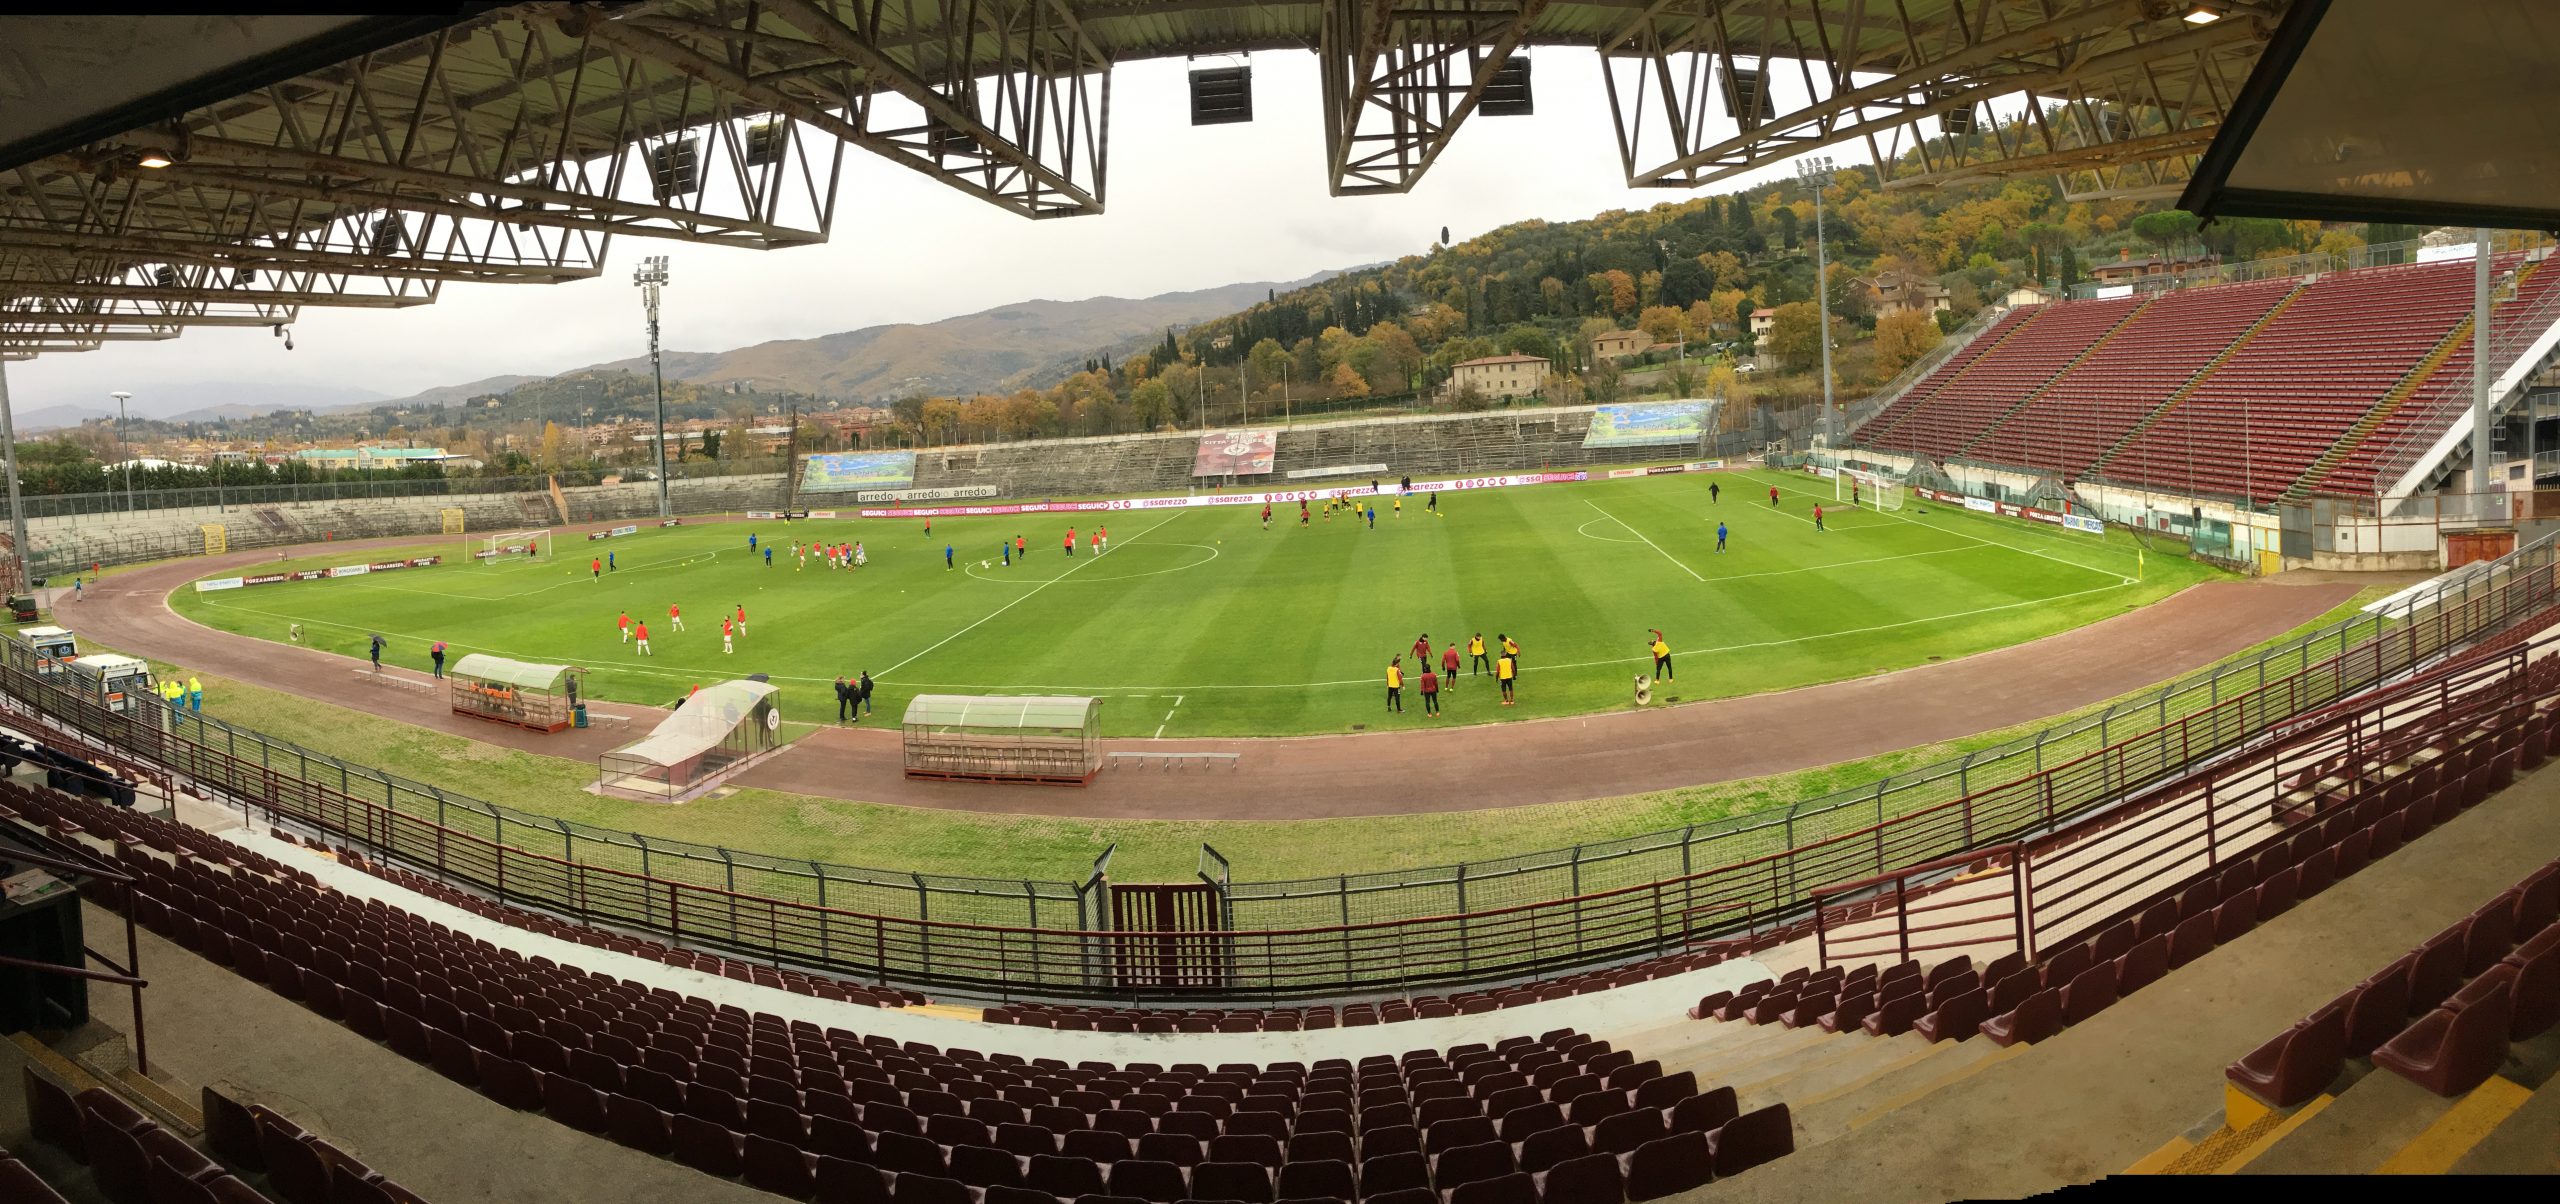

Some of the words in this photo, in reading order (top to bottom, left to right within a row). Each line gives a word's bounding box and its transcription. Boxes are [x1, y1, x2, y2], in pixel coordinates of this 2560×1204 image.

[913, 508, 939, 516] SEGUICI
[965, 507, 993, 515] SEGUICI
[1021, 503, 1049, 512] SEGUICI
